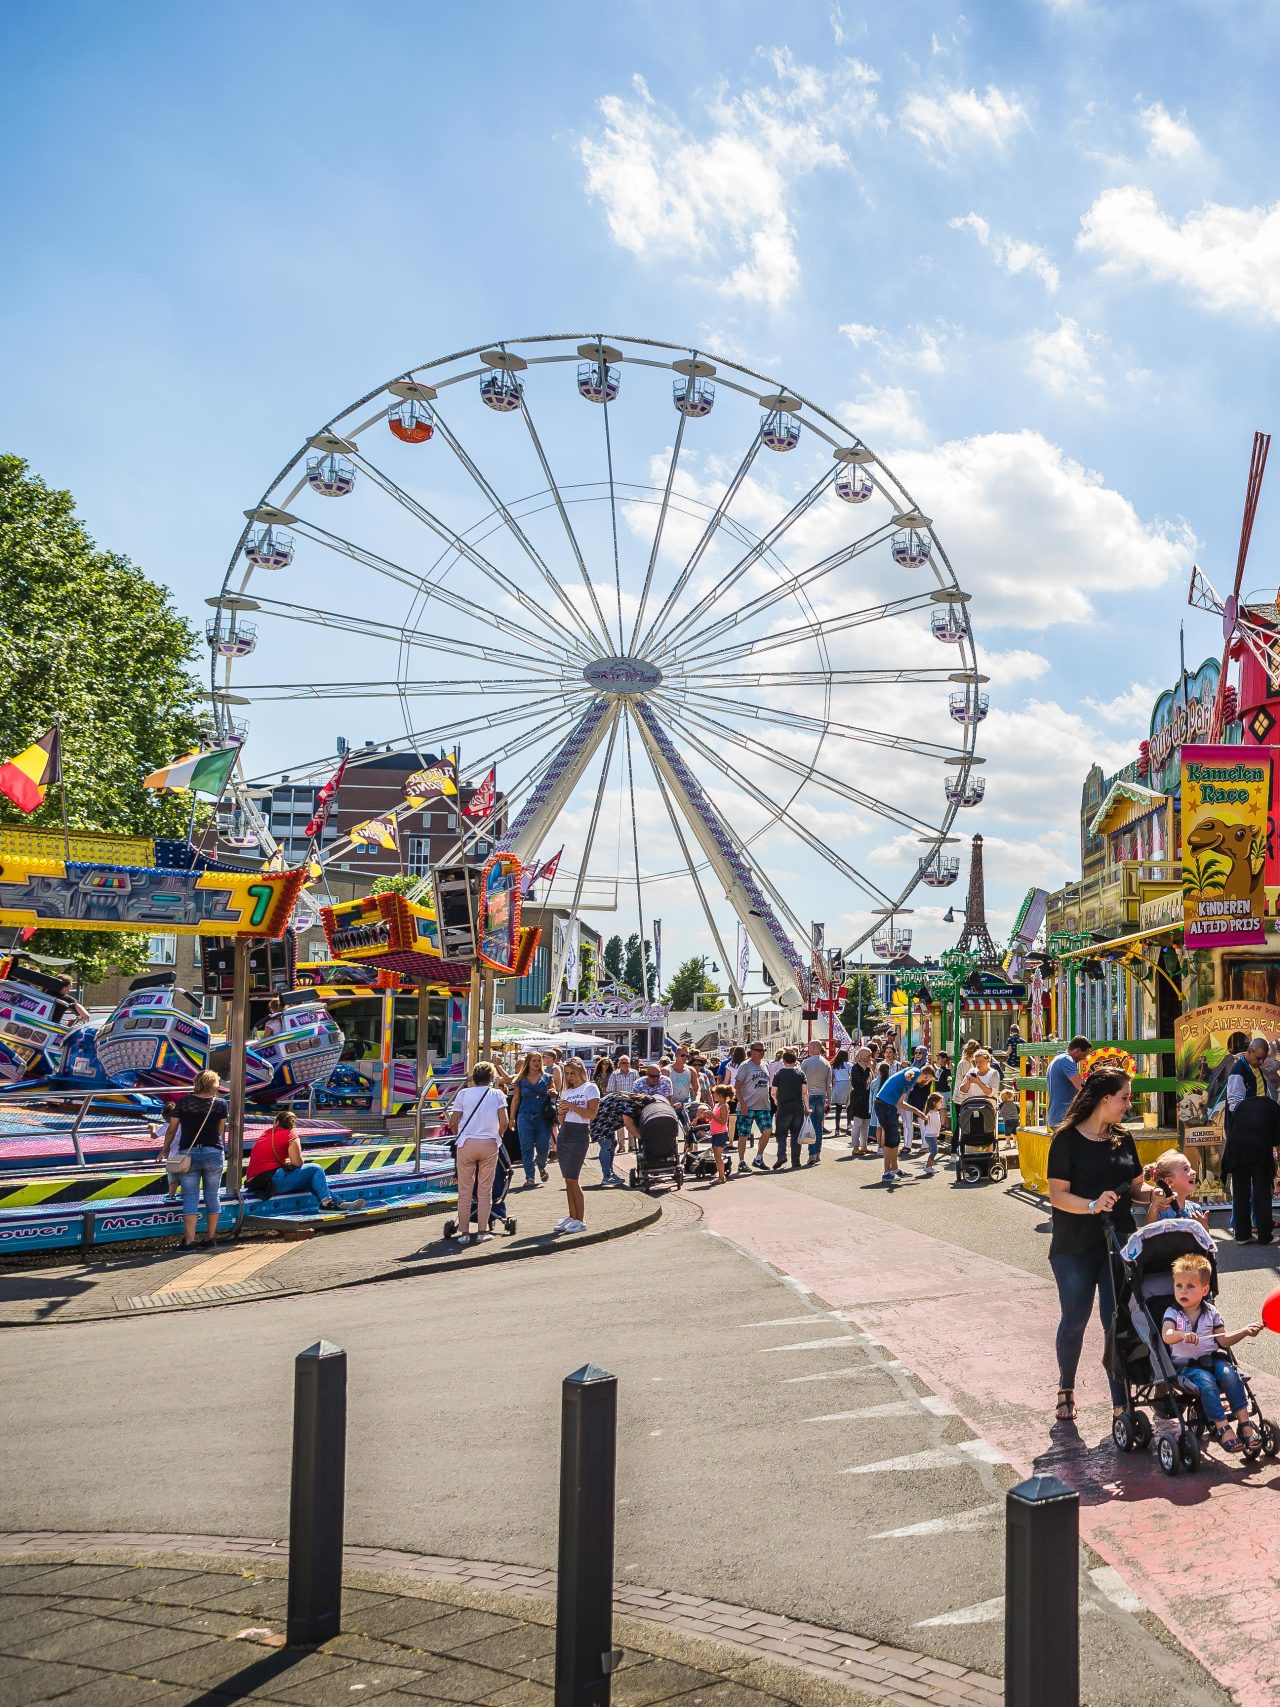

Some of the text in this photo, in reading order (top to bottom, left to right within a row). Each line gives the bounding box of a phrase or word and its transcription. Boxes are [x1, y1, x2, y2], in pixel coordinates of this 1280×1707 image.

[1185, 696, 1215, 744] Pari
[1186, 763, 1263, 783] Kamelen
[1200, 784, 1250, 805] Race
[247, 884, 273, 926] 7
[1190, 917, 1261, 935] ALTIJD PRIJS
[1179, 1023, 1200, 1042] DE
[101, 1212, 203, 1232] Machin
[0, 1225, 68, 1241] ower
